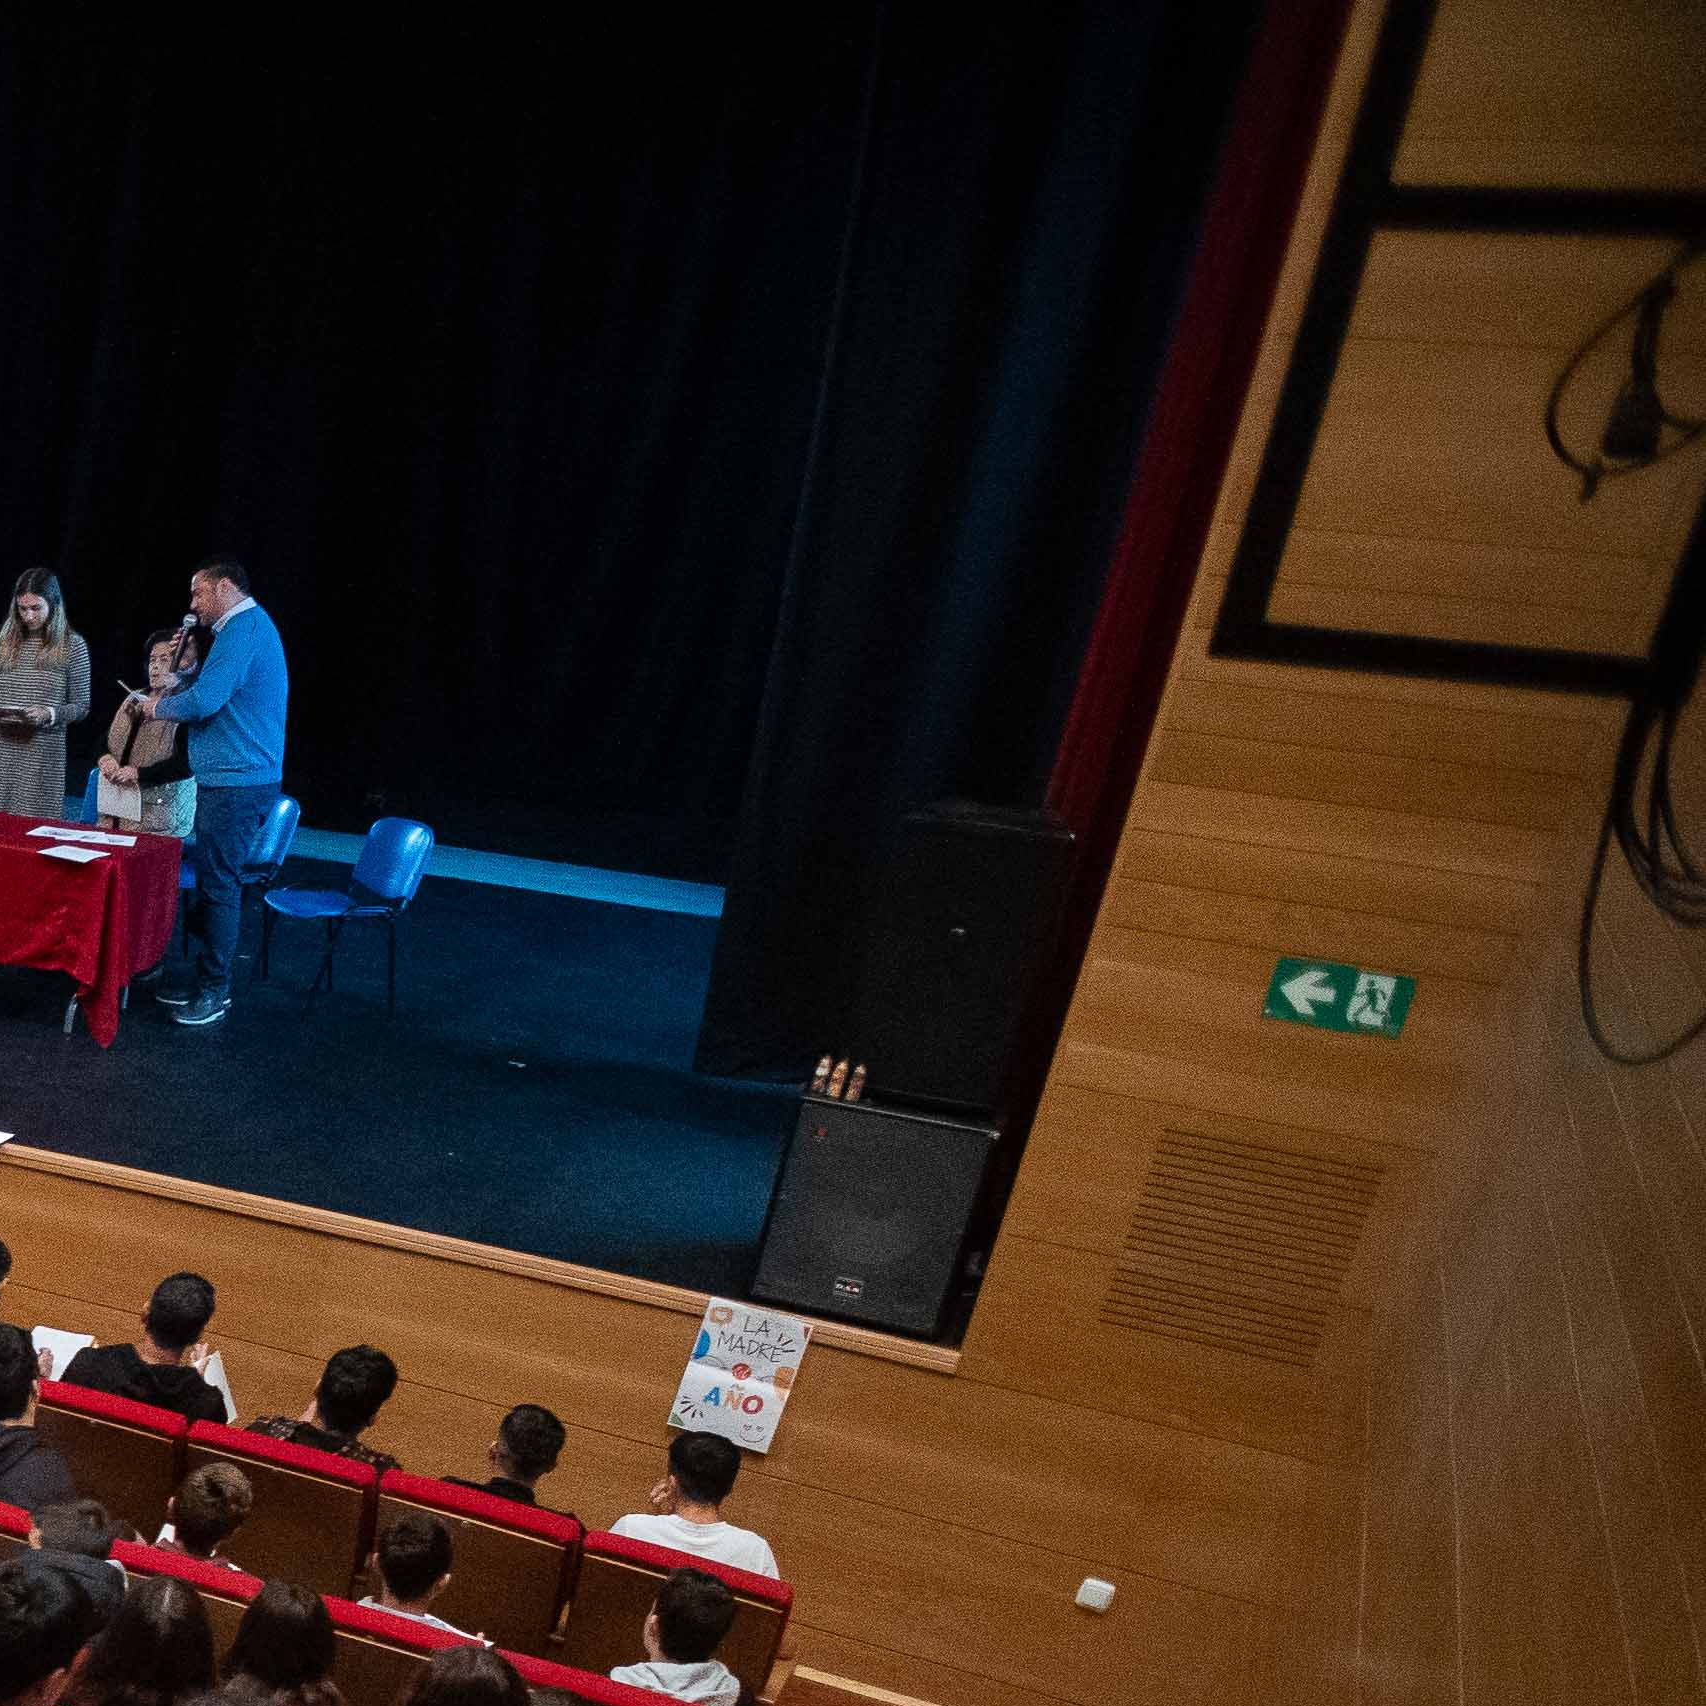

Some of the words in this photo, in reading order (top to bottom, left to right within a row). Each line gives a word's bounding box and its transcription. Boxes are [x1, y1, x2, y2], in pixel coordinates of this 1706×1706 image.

[743, 1315, 770, 1337] LA
[717, 1331, 784, 1363] MADRE
[703, 1383, 764, 1415] AÑO
